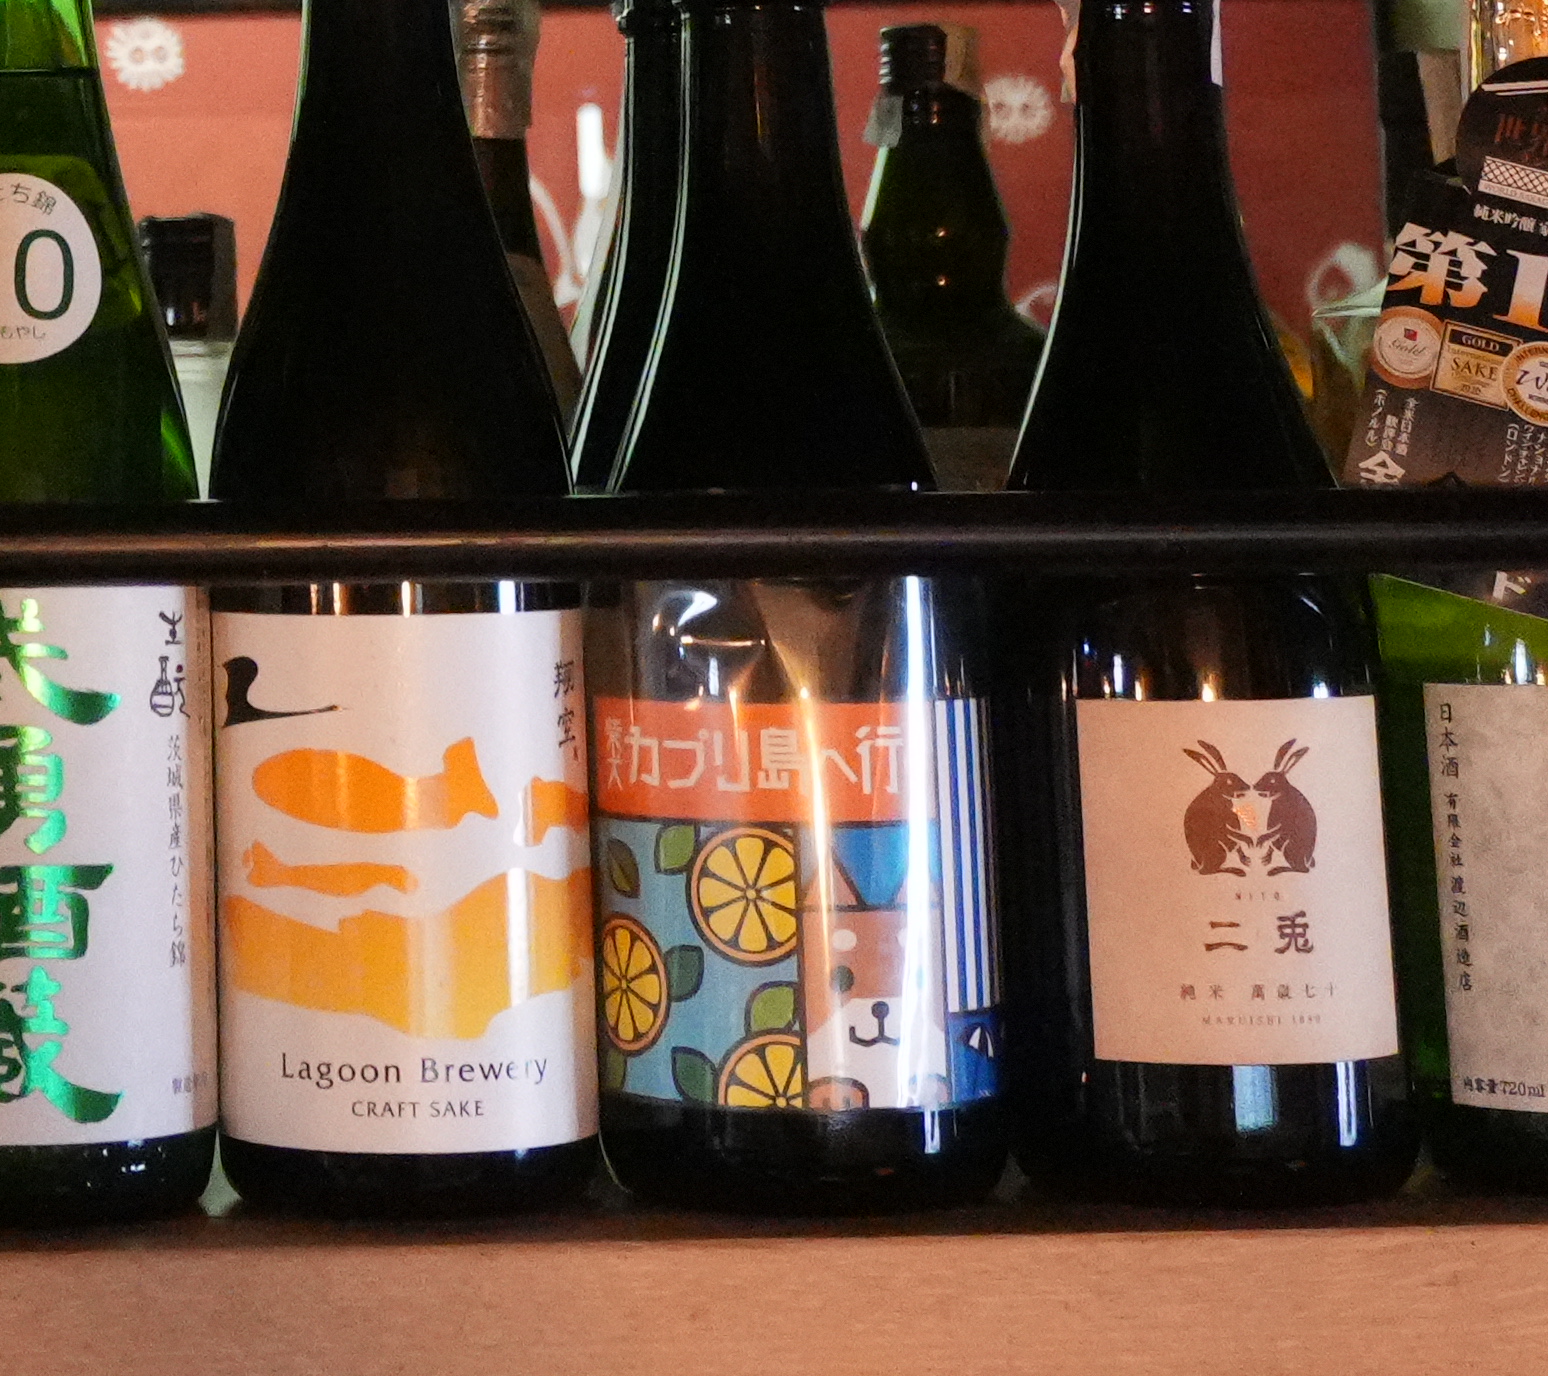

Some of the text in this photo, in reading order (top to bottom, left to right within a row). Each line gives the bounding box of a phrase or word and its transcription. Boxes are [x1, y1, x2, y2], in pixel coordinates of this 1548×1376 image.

[1461, 333, 1500, 354] GOLD
[1450, 355, 1500, 384] SAKE
[1438, 701, 1461, 780] 日本酒
[165, 734, 187, 969] 茨城県産ひたち錦
[280, 1051, 549, 1088] Lagoon Brewery
[350, 1098, 486, 1120] CRAFT SAKE
